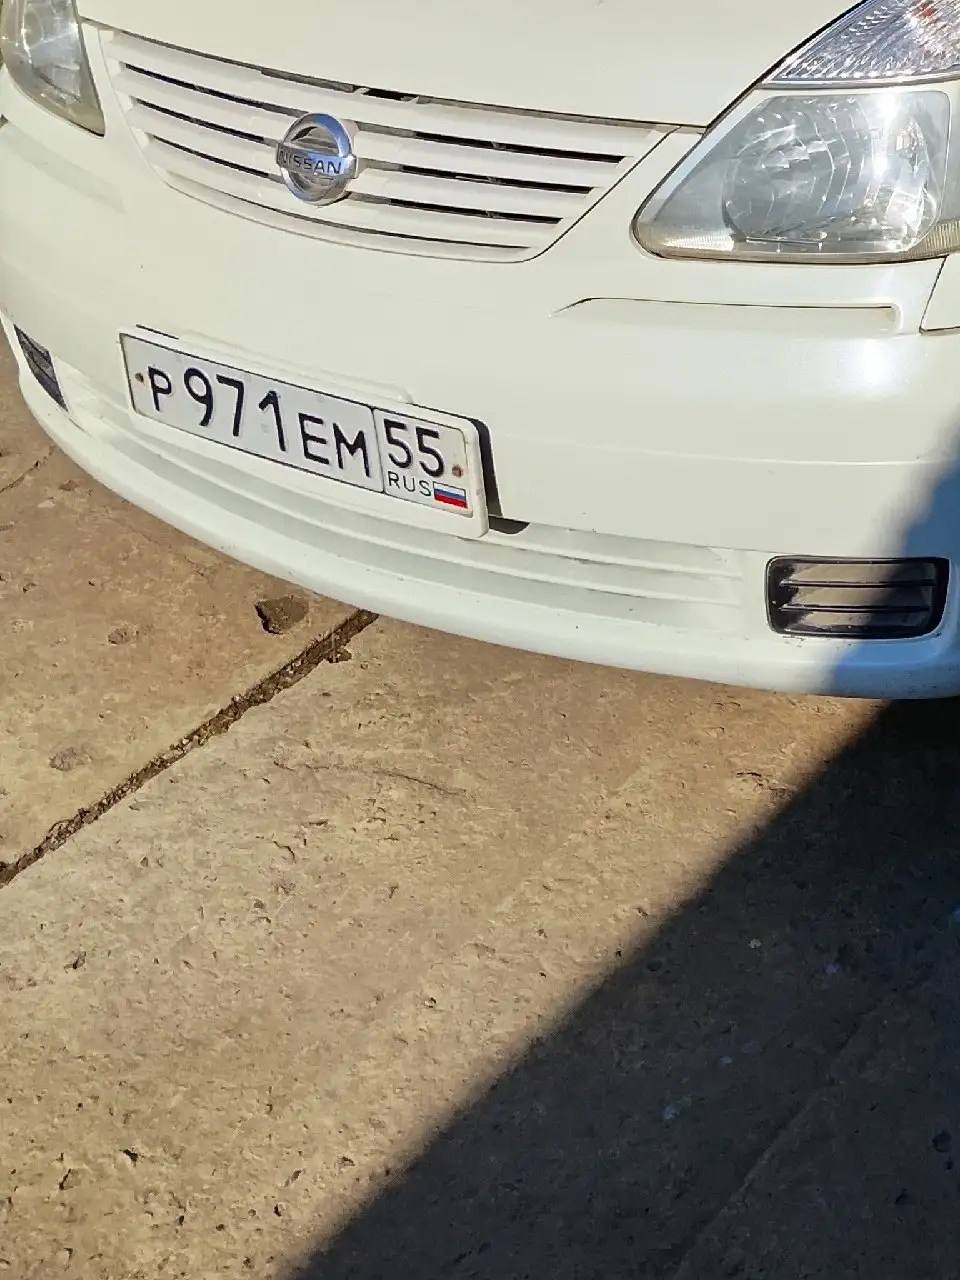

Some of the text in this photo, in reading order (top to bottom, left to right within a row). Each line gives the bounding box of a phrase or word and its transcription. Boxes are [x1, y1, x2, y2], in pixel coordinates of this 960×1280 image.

[279, 150, 342, 174] NISSAN
[383, 418, 445, 478] 55
[387, 470, 432, 497] RUS
